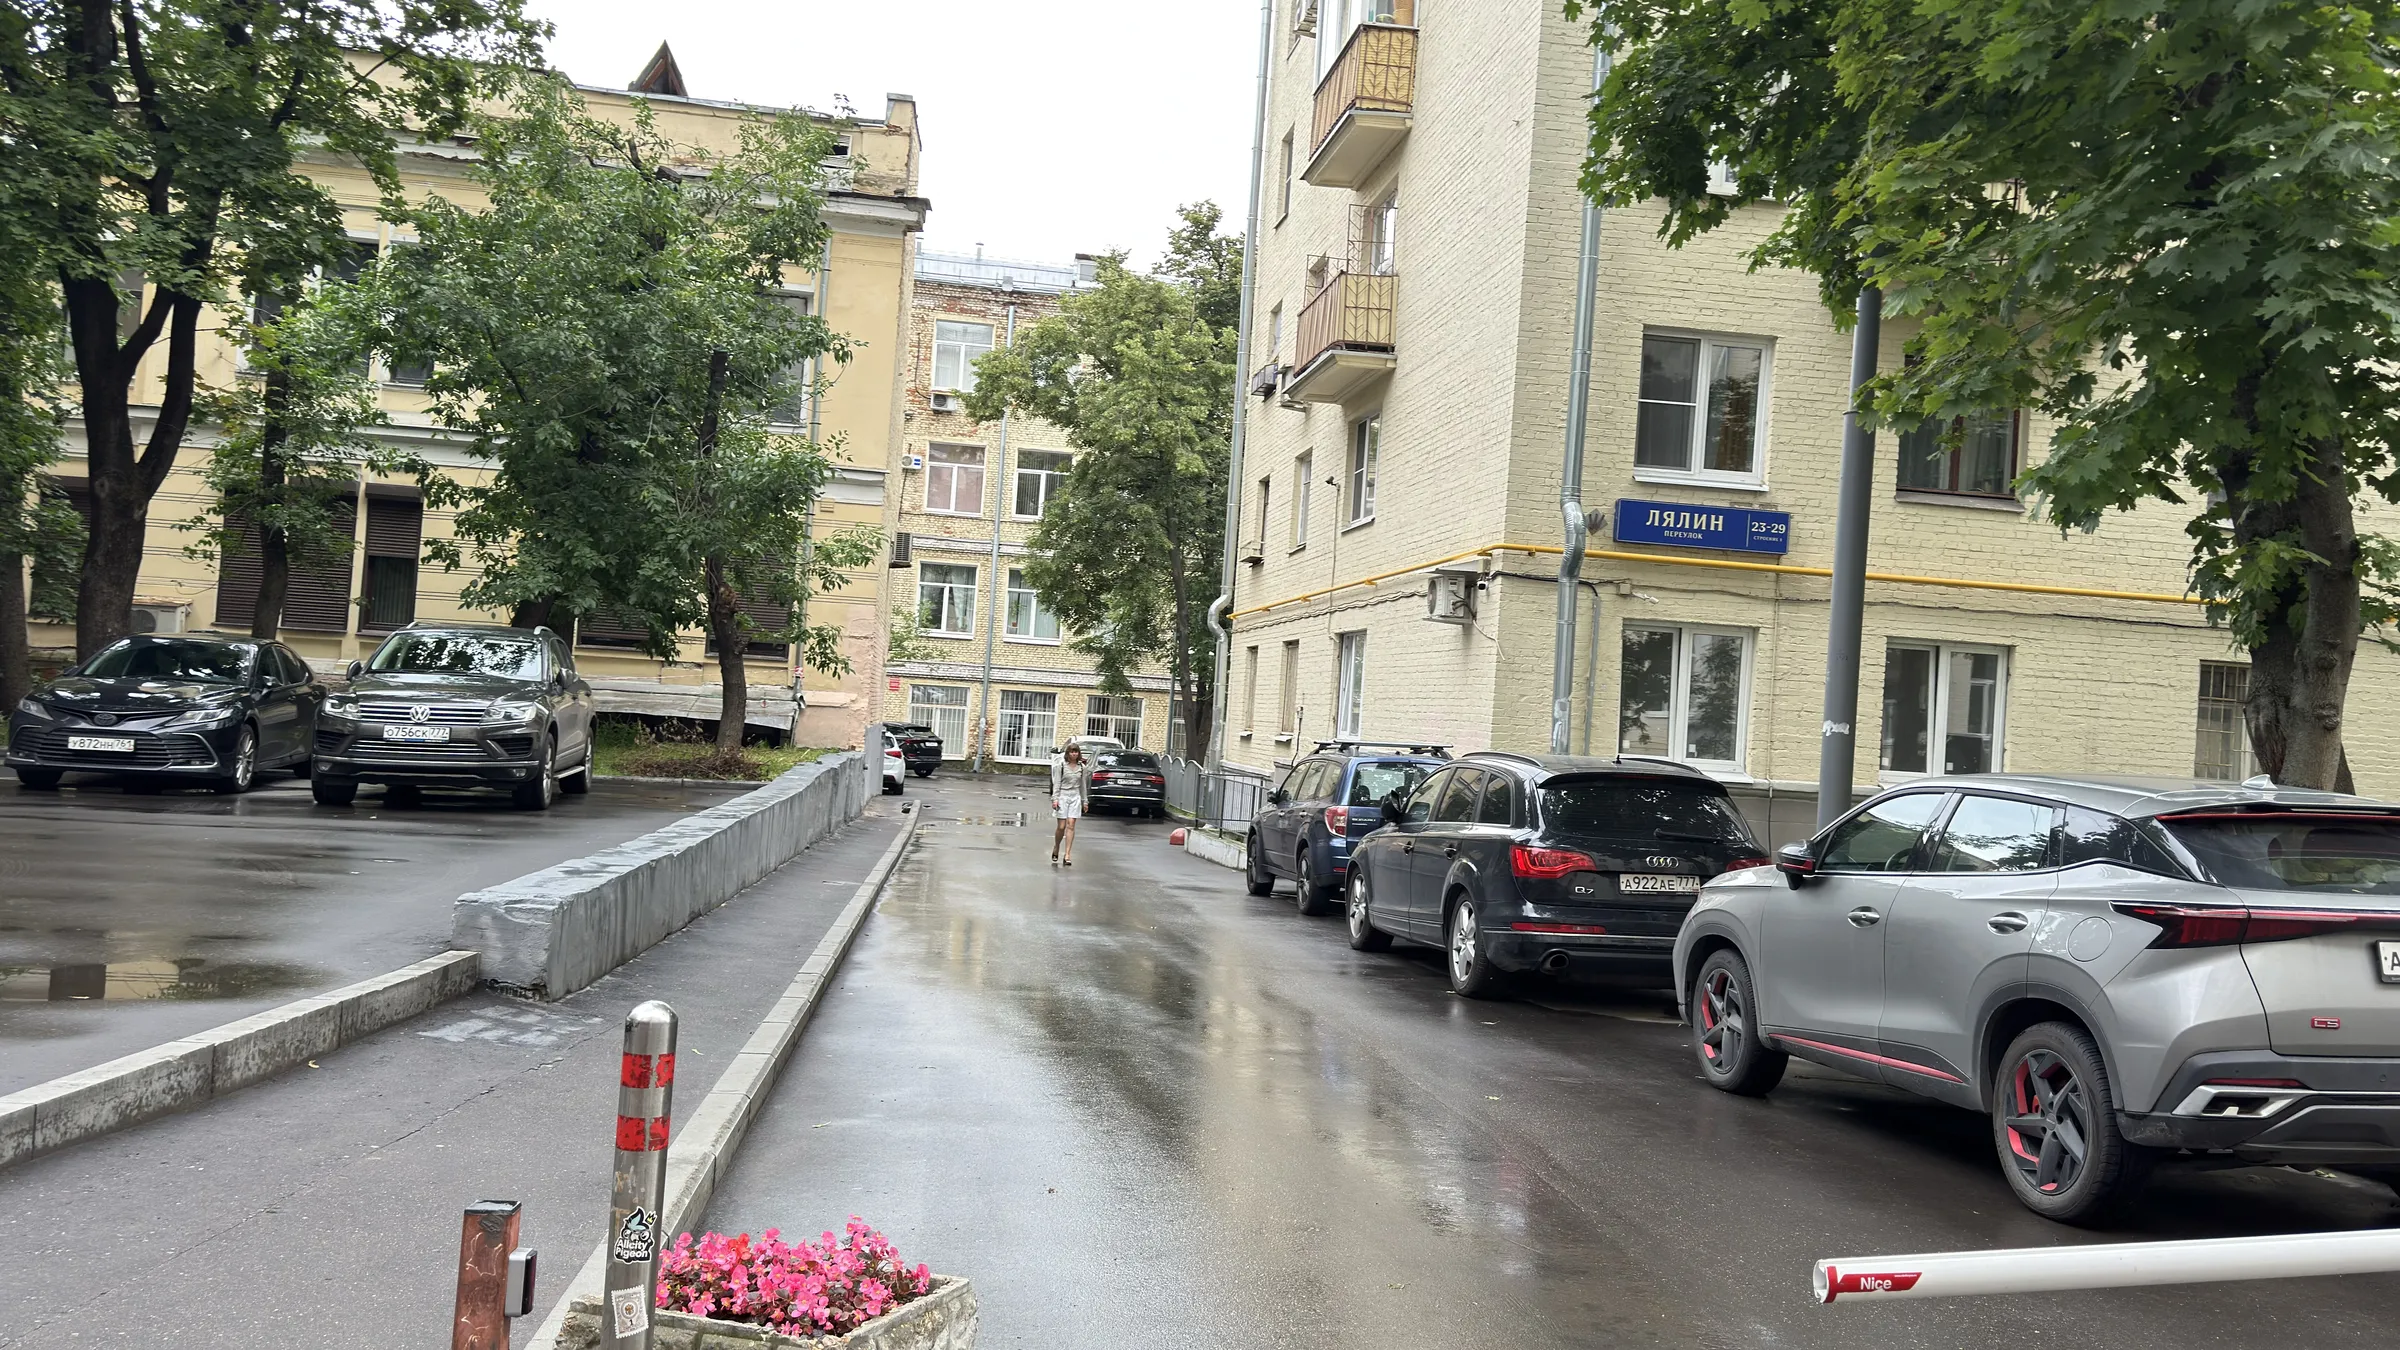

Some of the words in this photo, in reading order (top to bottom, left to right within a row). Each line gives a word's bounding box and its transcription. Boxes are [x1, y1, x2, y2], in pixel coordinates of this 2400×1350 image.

[1645, 509, 1724, 531] ЛЯЛИН
[1751, 521, 1786, 534] 23-29
[1664, 530, 1703, 540] ПЕРЕУЛОК
[1575, 886, 1594, 894] Q7
[617, 1239, 648, 1251] Allcity
[616, 1247, 648, 1259] Pigeon
[1860, 1277, 1892, 1290] Nice
